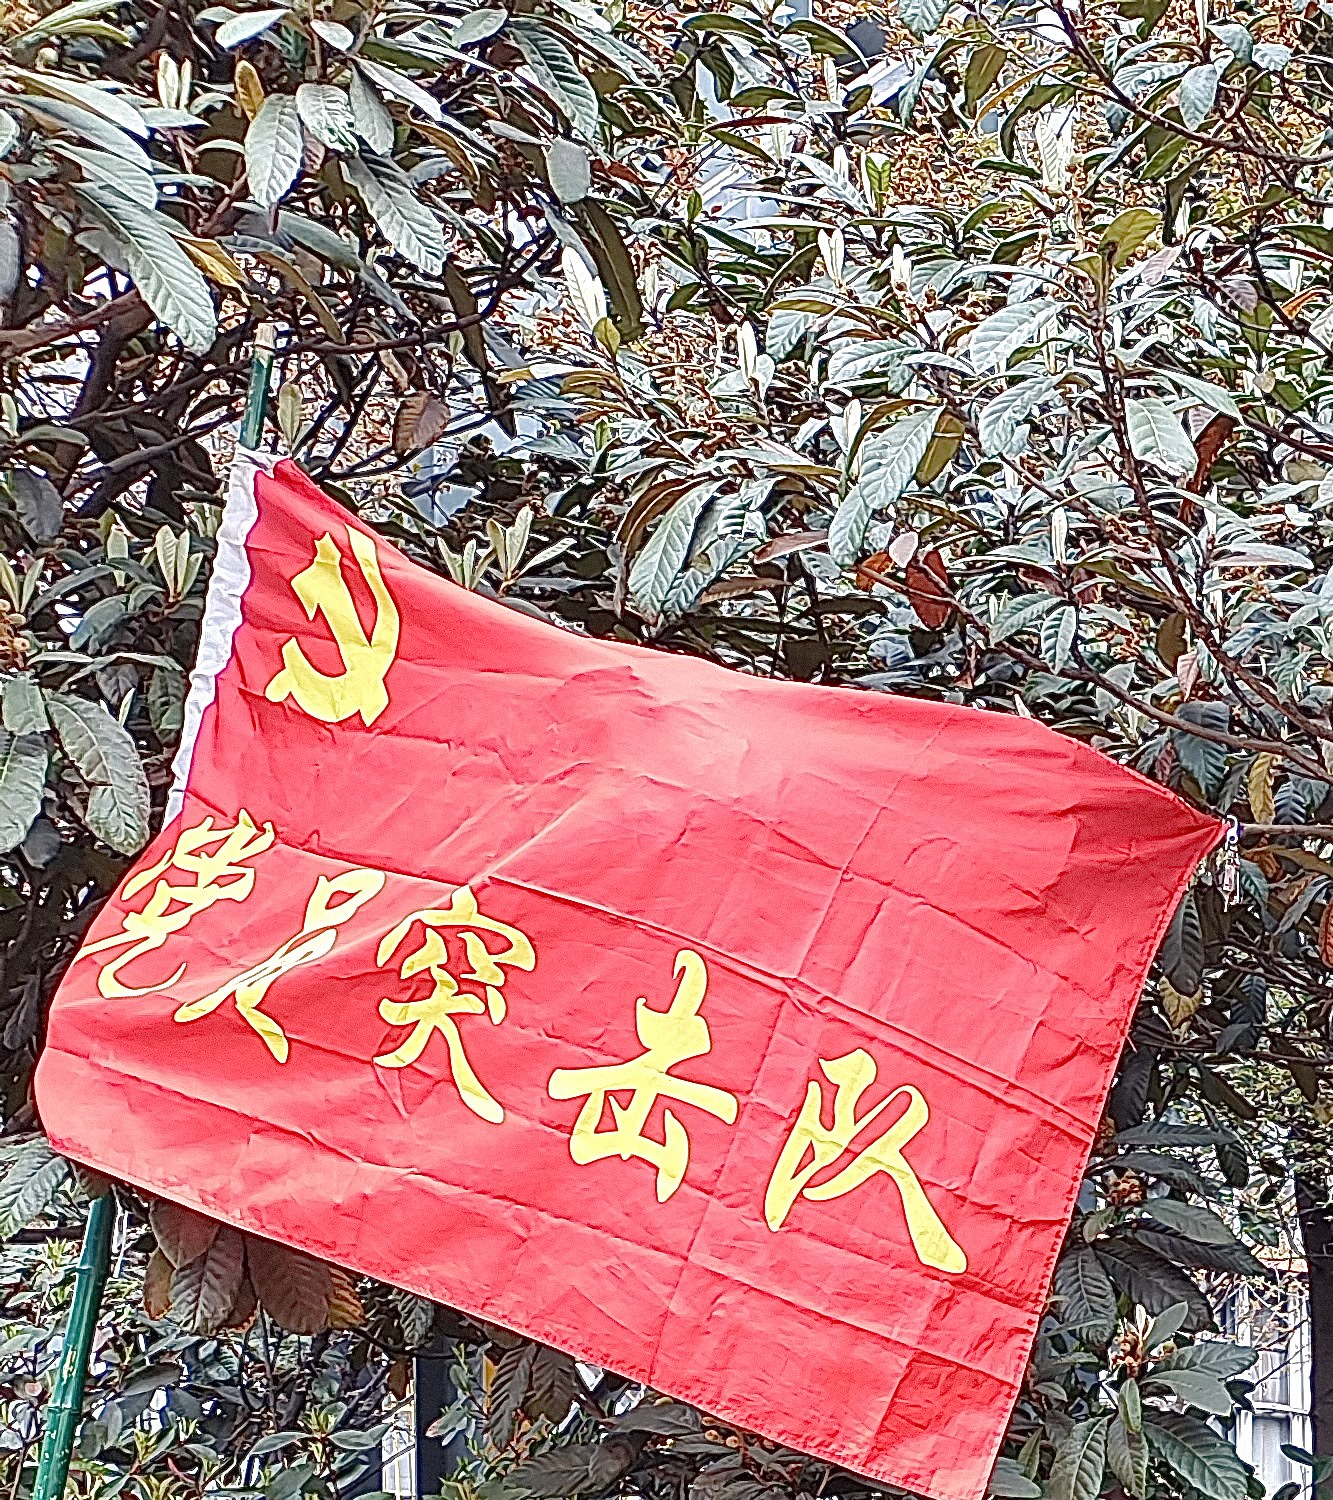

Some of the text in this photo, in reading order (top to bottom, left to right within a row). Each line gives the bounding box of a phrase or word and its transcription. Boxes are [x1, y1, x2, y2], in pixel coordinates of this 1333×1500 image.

[72, 808, 968, 1273] 党员突击队
